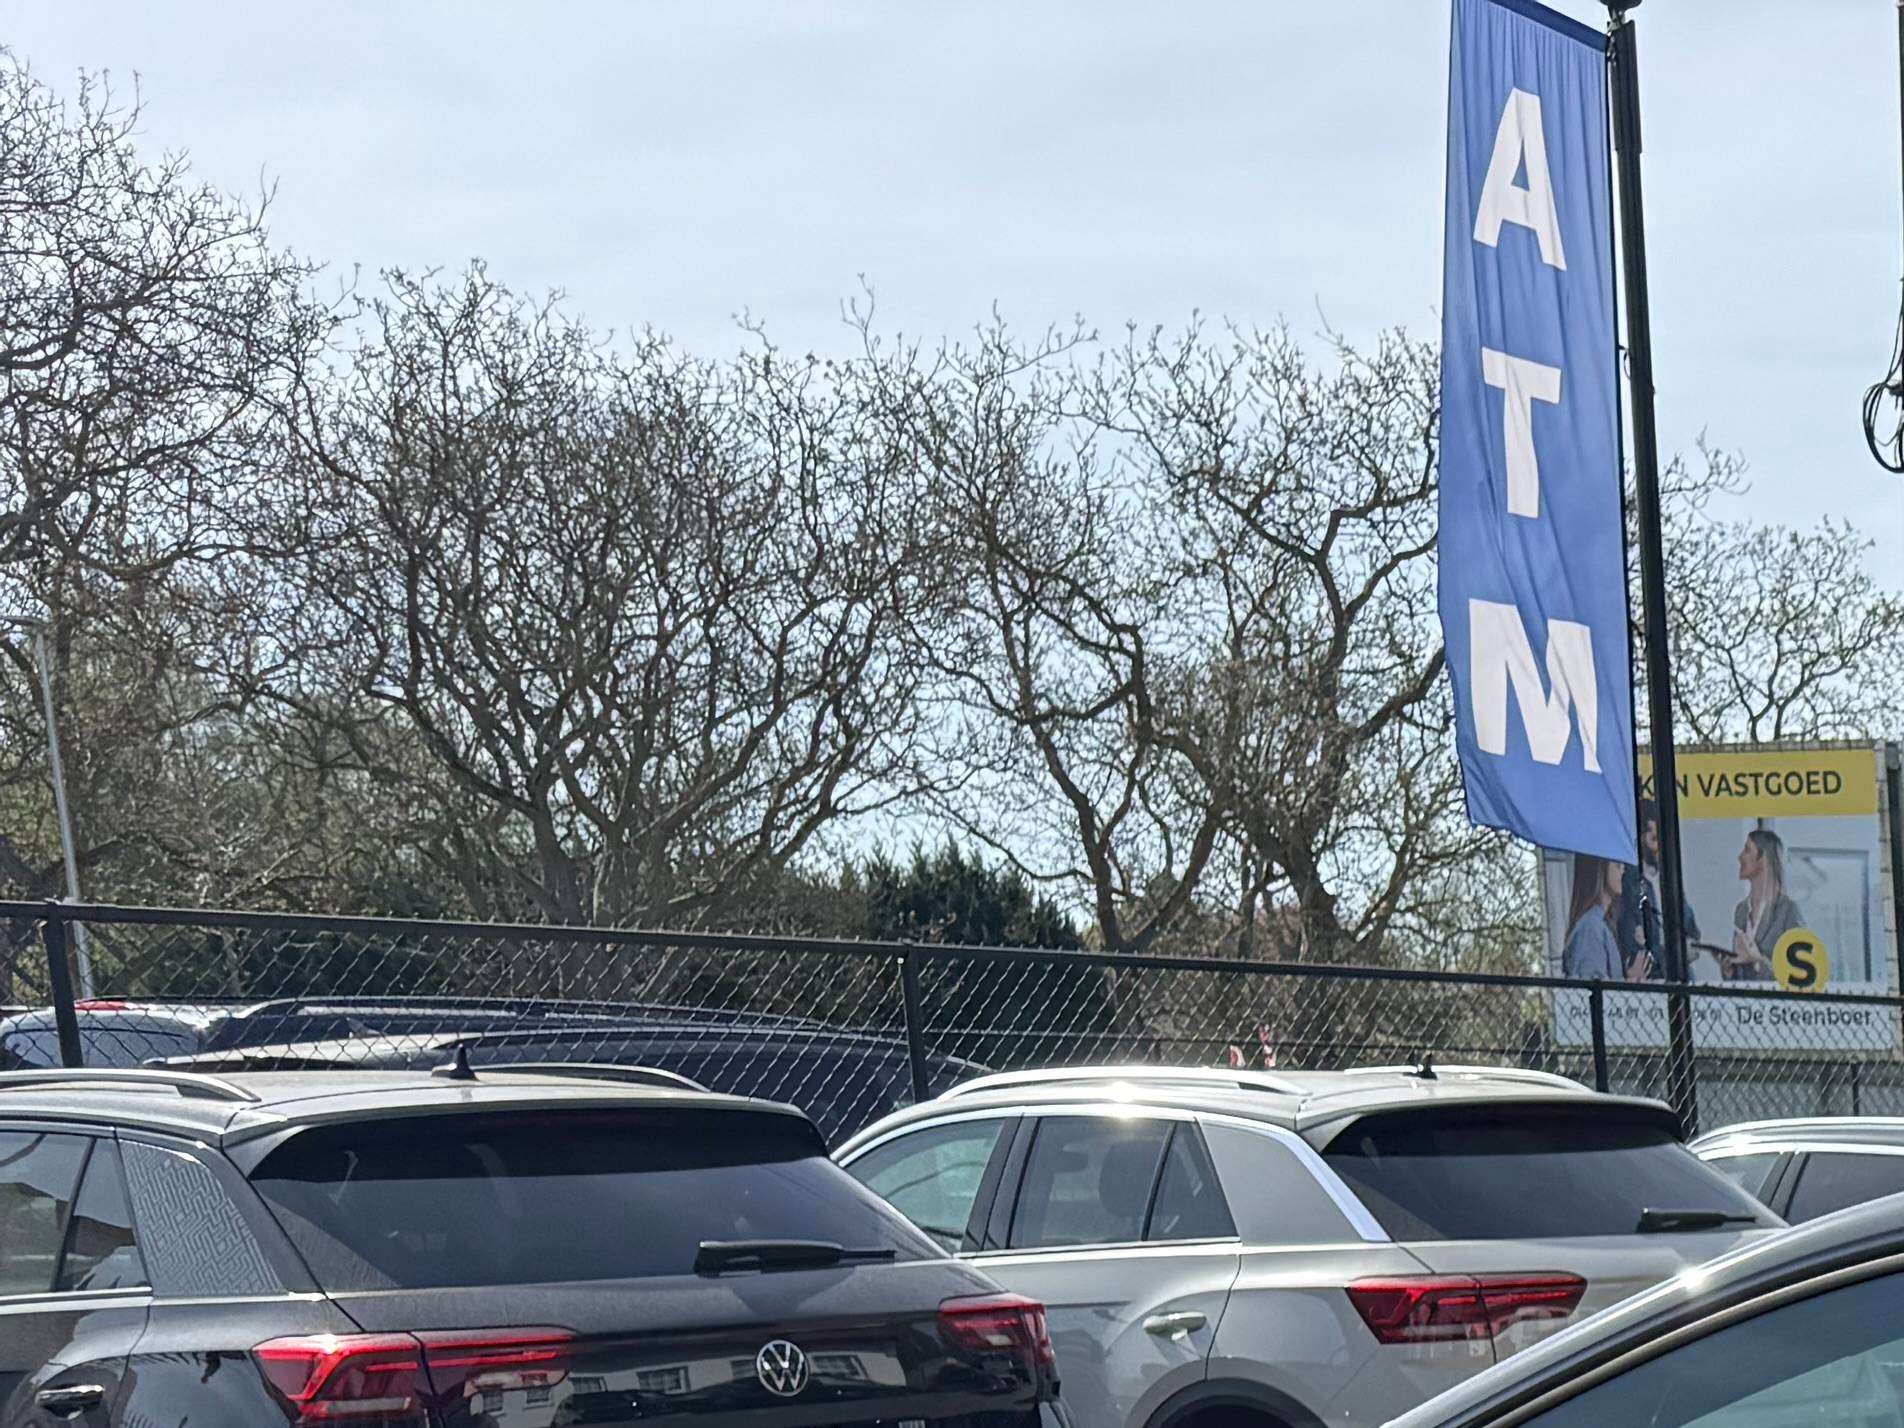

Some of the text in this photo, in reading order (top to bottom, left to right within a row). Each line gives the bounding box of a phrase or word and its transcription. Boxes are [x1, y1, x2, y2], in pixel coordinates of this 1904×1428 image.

[1469, 87, 1602, 774] ATM
[1697, 770, 1842, 797] VASTGOED
[1737, 1007, 1763, 1025] De
